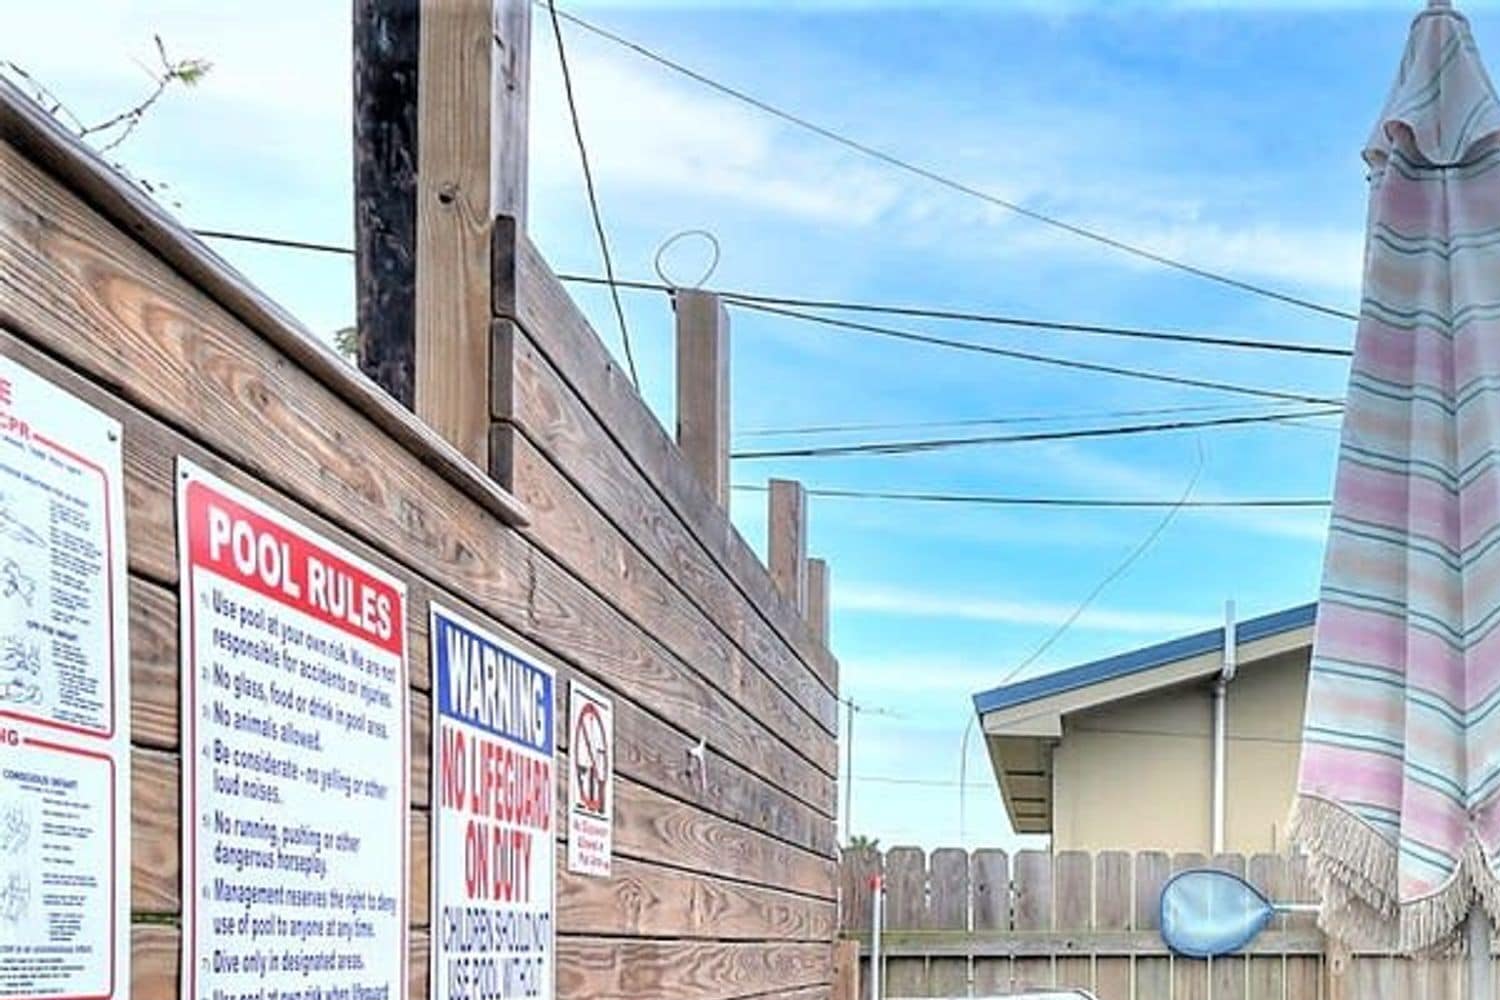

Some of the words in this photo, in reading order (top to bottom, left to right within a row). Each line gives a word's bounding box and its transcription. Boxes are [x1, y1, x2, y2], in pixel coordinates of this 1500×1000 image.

[208, 503, 301, 599] POOL
[307, 556, 391, 641] RULES
[212, 588, 237, 620] Use
[240, 606, 266, 630] pool
[268, 614, 279, 636] at
[281, 625, 304, 646] your
[306, 634, 326, 655] own
[351, 649, 364, 671] We
[366, 659, 381, 677] are
[382, 664, 396, 684] not
[212, 627, 280, 668] responsible
[282, 649, 298, 673] for
[300, 660, 346, 692] accidents
[348, 679, 358, 694] or
[213, 661, 231, 691] No
[270, 680, 294, 710] food
[296, 696, 306, 712] or
[308, 697, 333, 720] drink
[335, 703, 344, 724] in
[346, 712, 366, 733] pool
[446, 624, 546, 749] WARNING
[213, 700, 231, 728] No
[234, 709, 278, 740] animals
[213, 767, 240, 797] loud
[214, 738, 230, 765] Be
[233, 748, 298, 781] considerate
[306, 768, 319, 785] no
[320, 769, 351, 798] yelling
[353, 779, 363, 794] or
[365, 780, 388, 800] other
[442, 724, 465, 811] NO
[470, 735, 551, 832] LIFEGUARD
[214, 809, 231, 836] No
[282, 824, 322, 854] pushing
[324, 832, 333, 849] or
[336, 831, 361, 854] other
[213, 841, 275, 873] dangerous
[465, 819, 489, 900] ON
[493, 826, 533, 903] DUTY
[214, 878, 284, 910] Management
[286, 889, 327, 908] reserves
[330, 889, 344, 910] the
[345, 888, 366, 916] right
[368, 890, 377, 911] to
[378, 892, 397, 917] deny
[213, 917, 236, 936] use
[238, 912, 249, 934] of
[252, 914, 276, 941] pool
[278, 915, 287, 936] to
[290, 919, 324, 942] anyone
[326, 919, 336, 937] at
[338, 921, 353, 942] any
[443, 906, 494, 953] CHILDREN
[495, 910, 531, 952] SHOULD
[533, 912, 550, 952] NOT
[213, 949, 239, 974] Dive
[243, 950, 266, 978] only
[268, 951, 279, 971] in
[282, 949, 336, 977] designated
[472, 957, 501, 1000] POOL
[502, 957, 543, 998] WITHOUT
